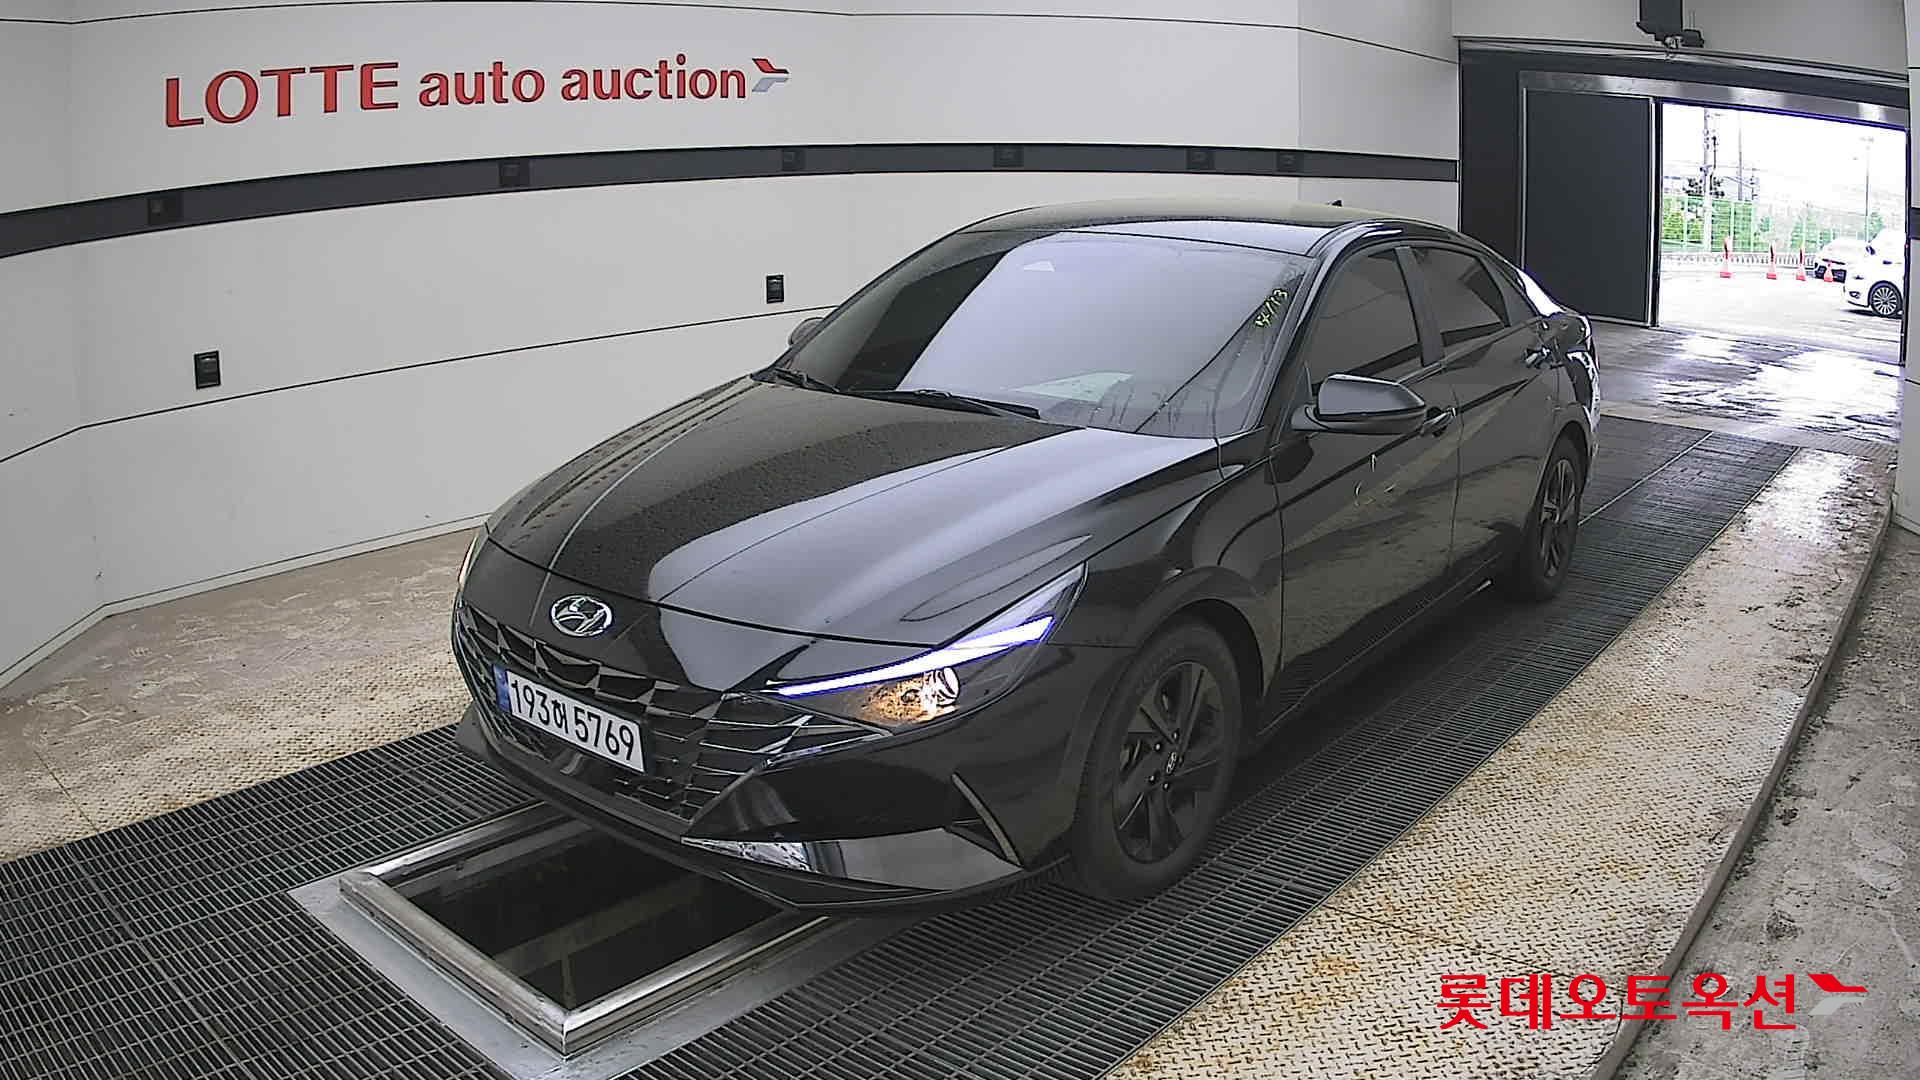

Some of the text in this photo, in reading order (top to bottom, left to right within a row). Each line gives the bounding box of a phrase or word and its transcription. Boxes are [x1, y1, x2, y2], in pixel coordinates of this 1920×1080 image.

[165, 52, 747, 128] LOTTE auto auction
[511, 679, 635, 761] 193허 5769
